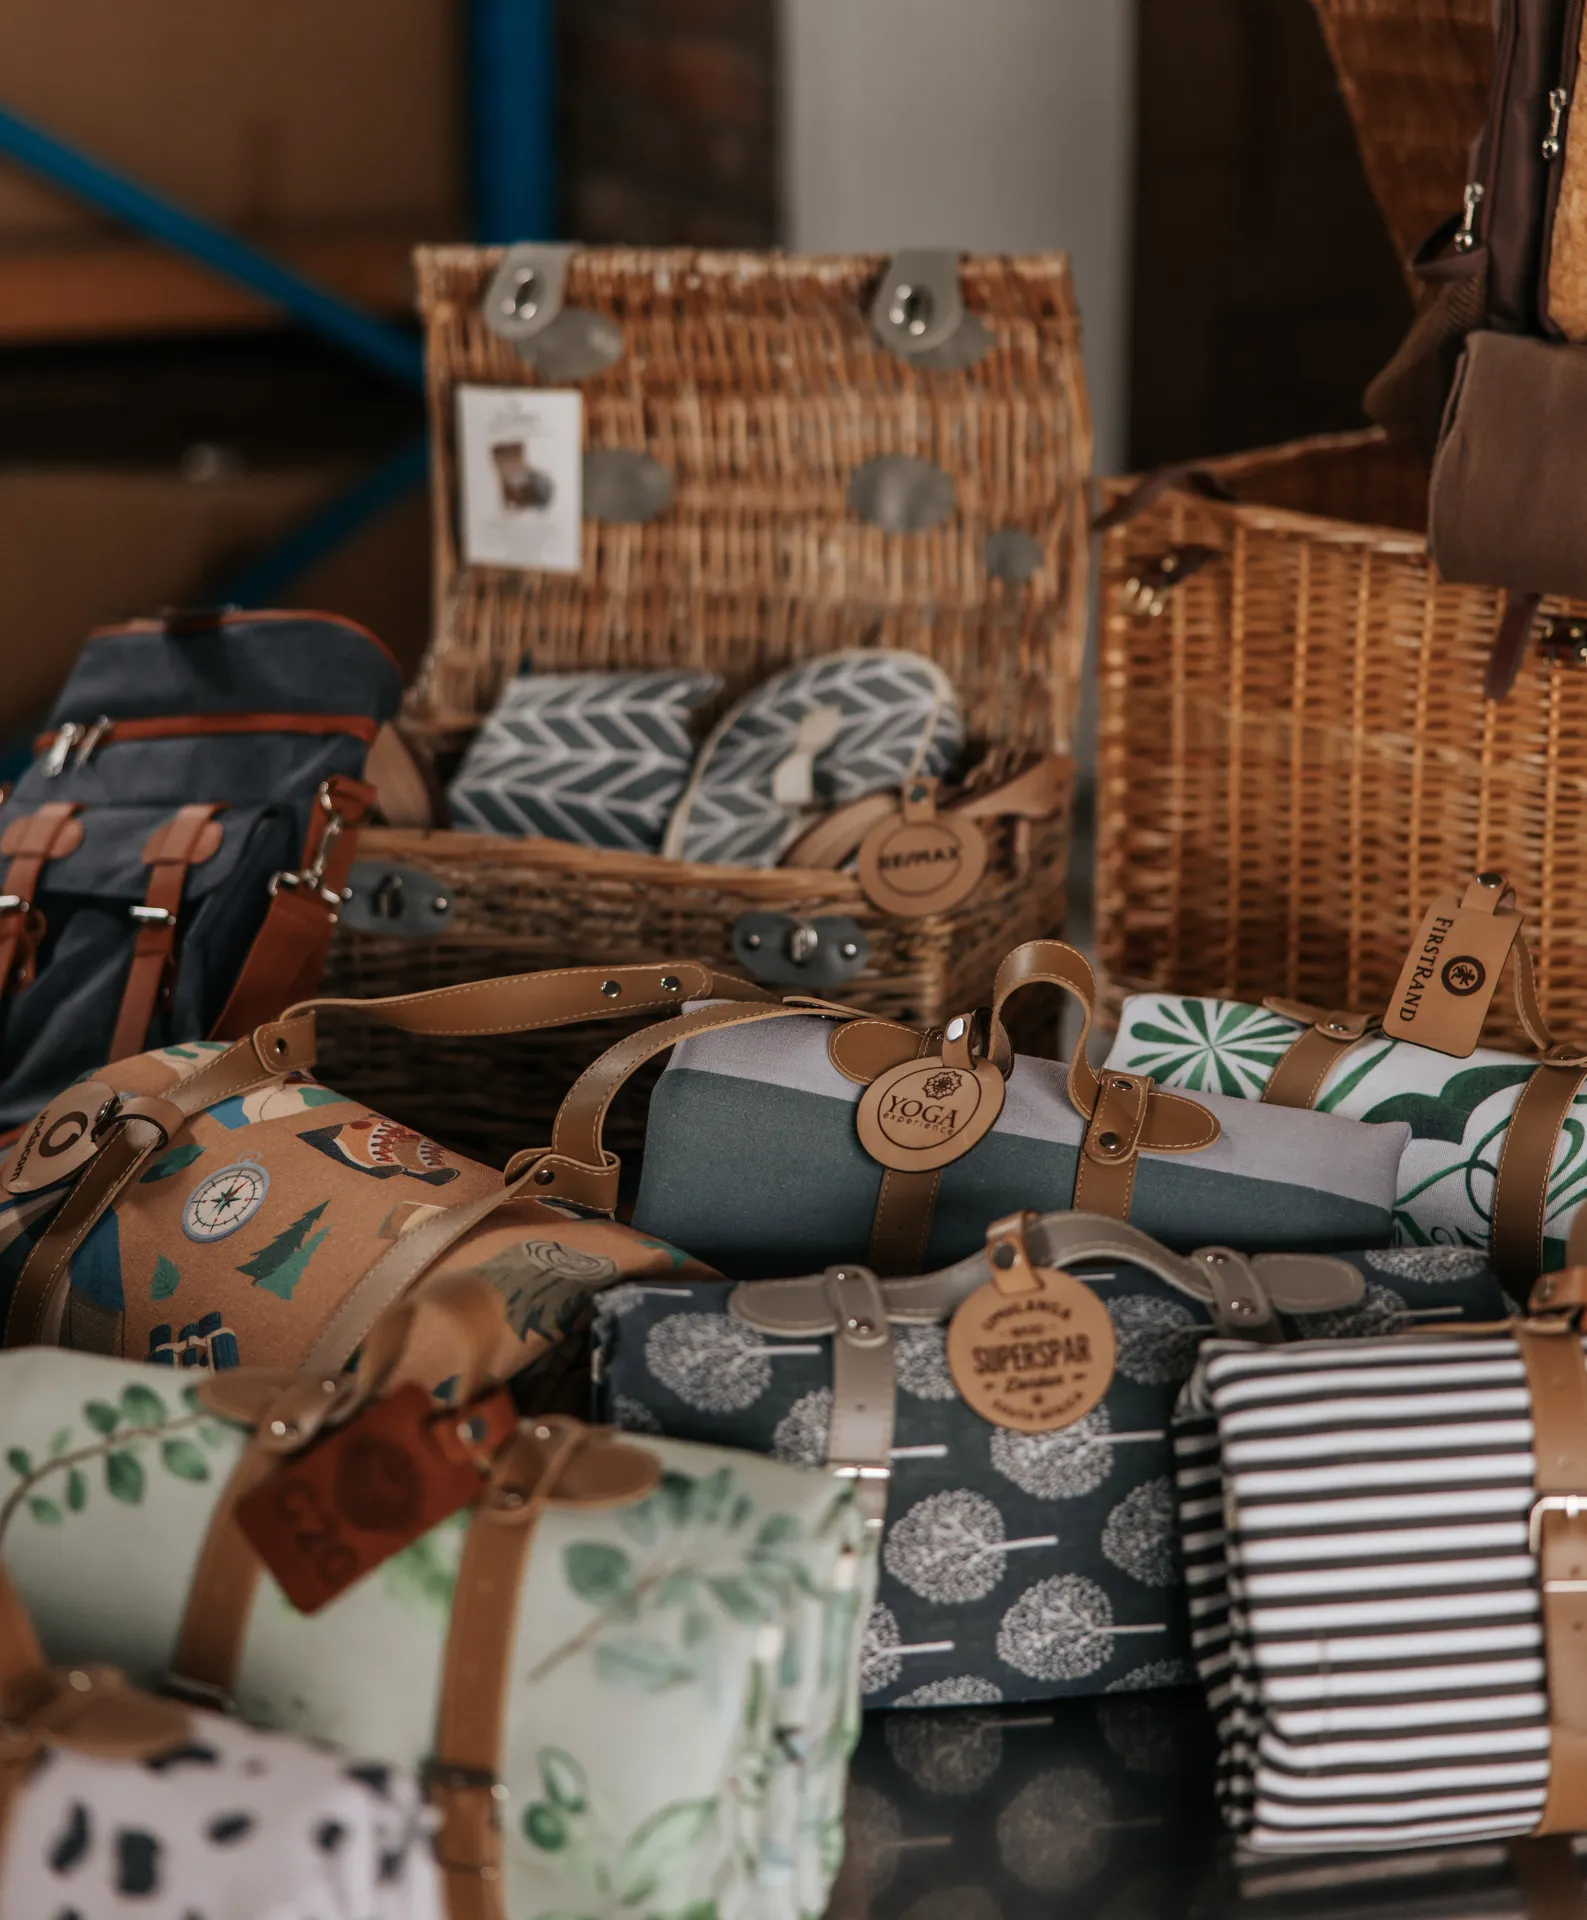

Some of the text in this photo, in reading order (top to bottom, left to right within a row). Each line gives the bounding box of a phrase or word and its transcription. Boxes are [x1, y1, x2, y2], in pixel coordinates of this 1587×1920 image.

[1400, 917, 1454, 1022] FIRSTRAND
[883, 1111, 954, 1135] experience
[888, 1095, 959, 1128] YOGA
[9, 1110, 50, 1182] vodacom
[971, 1333, 1092, 1377] SUPERSPAR
